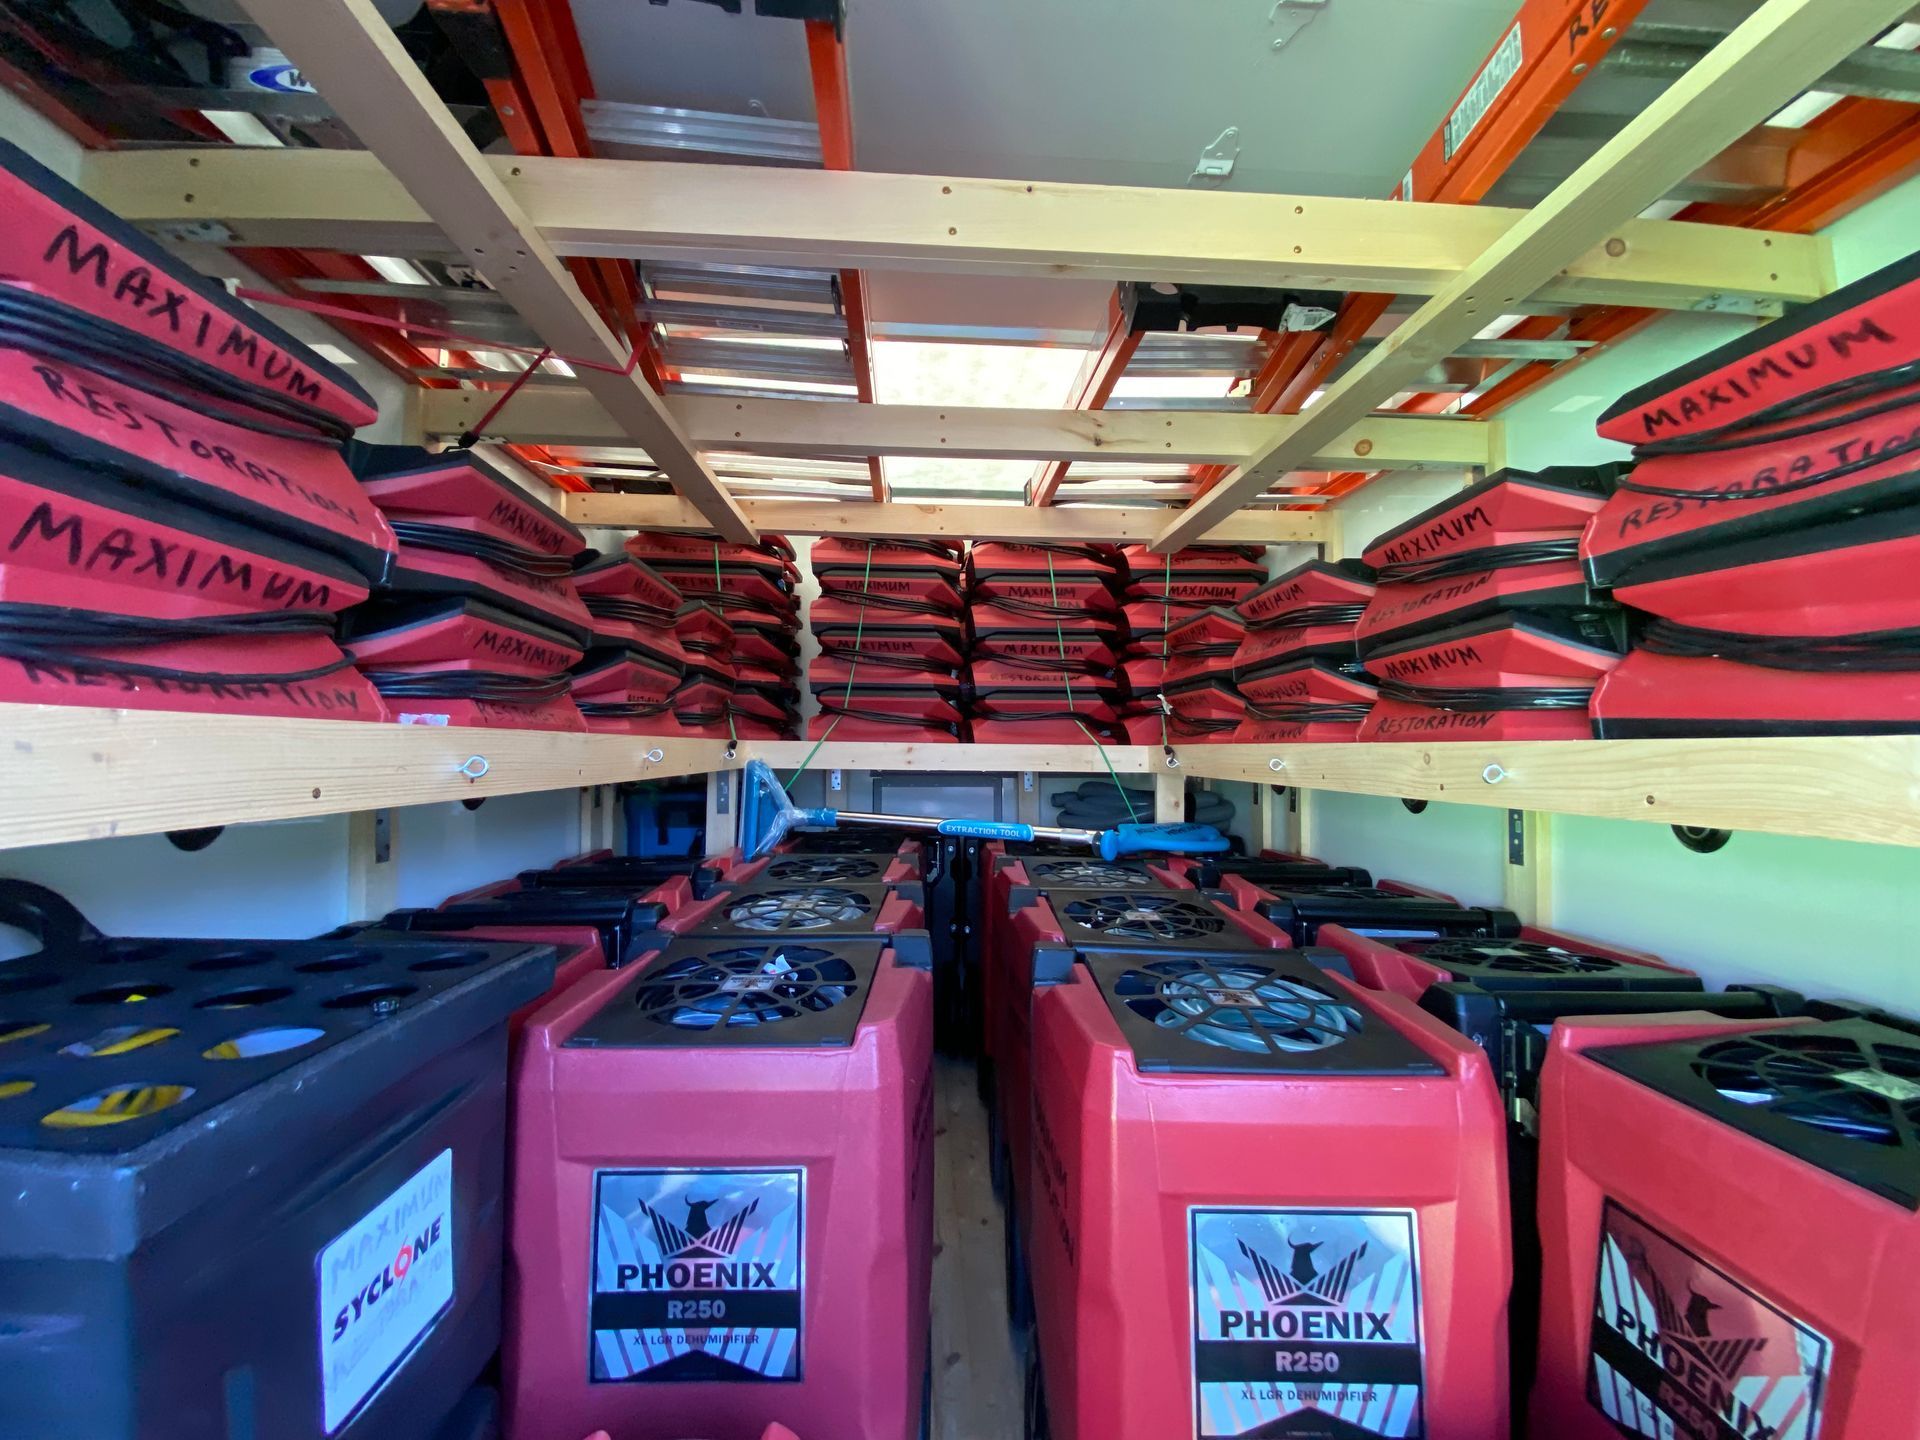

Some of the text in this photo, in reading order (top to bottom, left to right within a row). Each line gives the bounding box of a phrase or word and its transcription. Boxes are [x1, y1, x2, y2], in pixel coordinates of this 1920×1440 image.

[43, 225, 321, 402] MAXIMUM
[1643, 317, 1896, 437] MAXIMUM
[32, 365, 359, 525] RESTORATION
[1619, 420, 1920, 539] RESTORATIO
[1384, 506, 1493, 563] MAXIMUM
[8, 501, 330, 607] MAXIMUM
[845, 580, 911, 593] MAXIMUM
[1007, 585, 1076, 598] MAXIMUM
[1169, 585, 1237, 599] MAXIMUM
[473, 630, 571, 667] MAXIMUM
[837, 639, 915, 652] MAXIMUM
[1003, 644, 1083, 656] MAXIMUM
[1384, 644, 1483, 679] MAXIMUM
[1375, 713, 1496, 736] RESTORATION
[946, 825, 1021, 838] EXTRACTION TOOL
[332, 1213, 443, 1344] SYCLONE
[617, 1262, 776, 1290] PHOENIX
[667, 1299, 726, 1320] R250
[1219, 1310, 1393, 1341] PHOENIX
[633, 1334, 760, 1346] XL LGR DEHUMIDIFIER
[1275, 1351, 1340, 1373] R250
[1615, 1303, 1778, 1440] PHOENIX
[1241, 1389, 1378, 1402] XL LGR DEHUMIDIFIER
